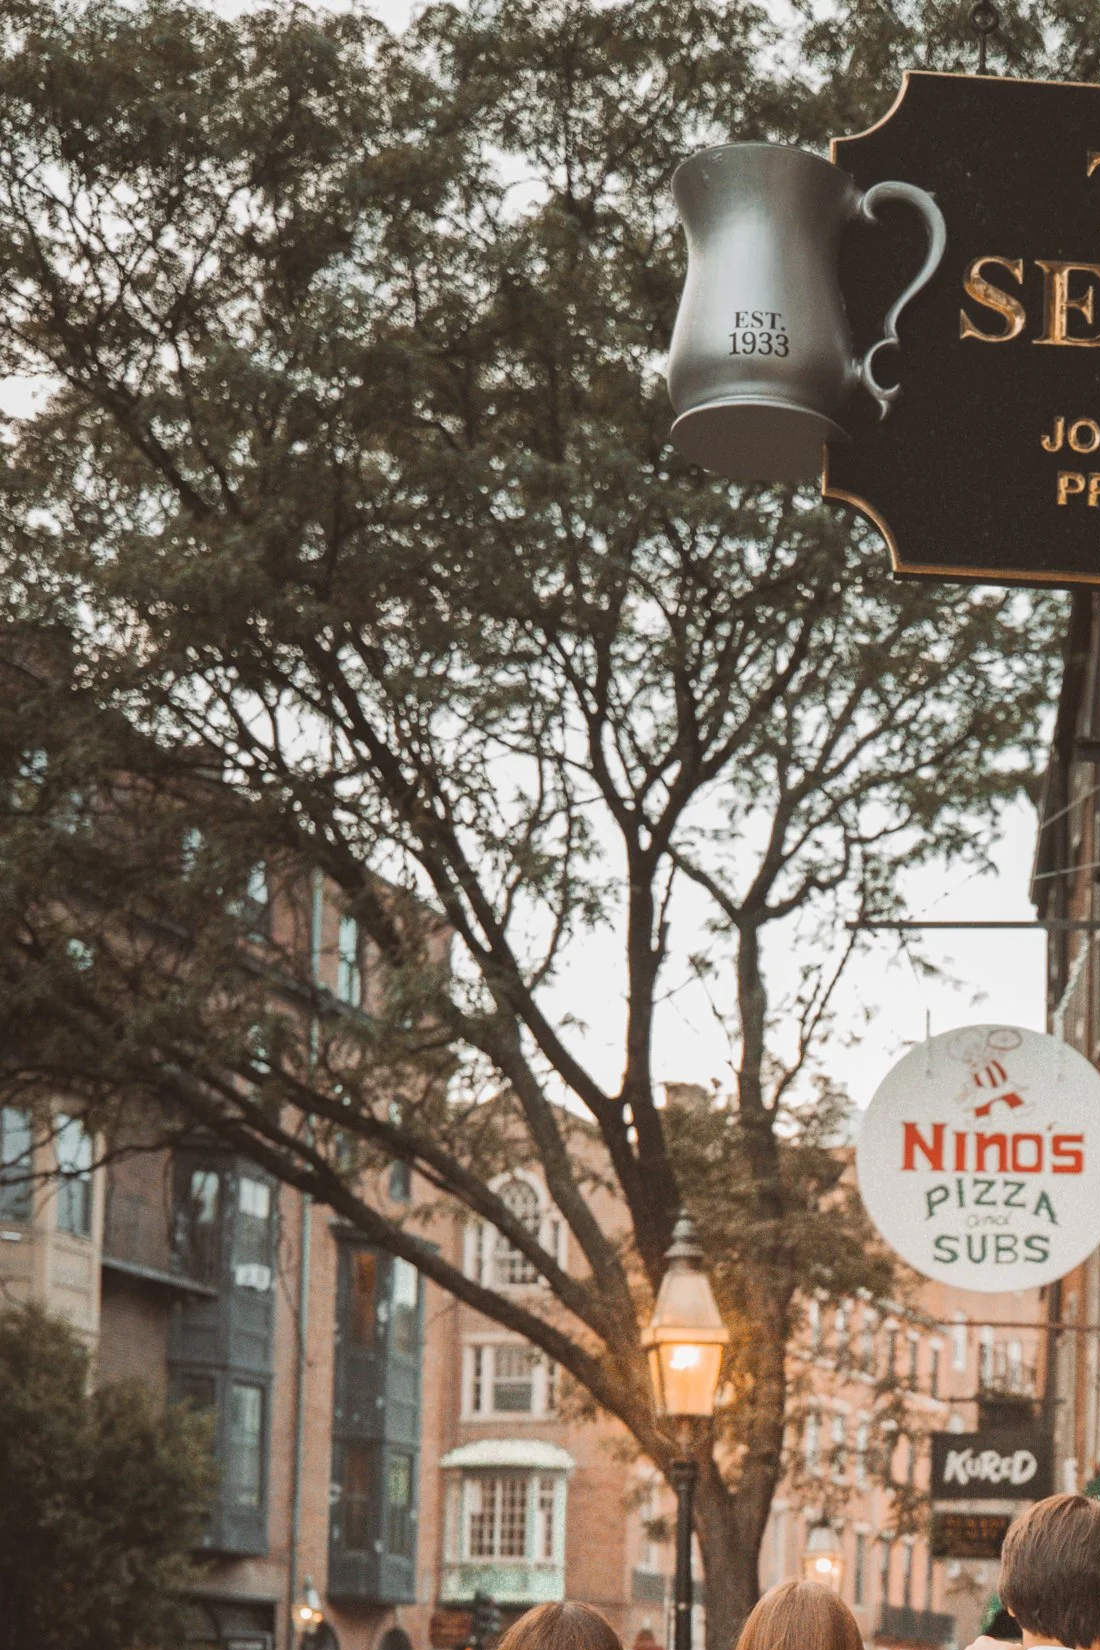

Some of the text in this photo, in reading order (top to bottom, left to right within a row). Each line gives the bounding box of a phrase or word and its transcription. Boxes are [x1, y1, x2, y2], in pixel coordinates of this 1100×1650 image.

[734, 310, 787, 333] EST.
[727, 331, 791, 359] 1933
[925, 1177, 1061, 1226] PIZZA
[967, 1211, 1013, 1228] and
[933, 1234, 1051, 1265] SUBS
